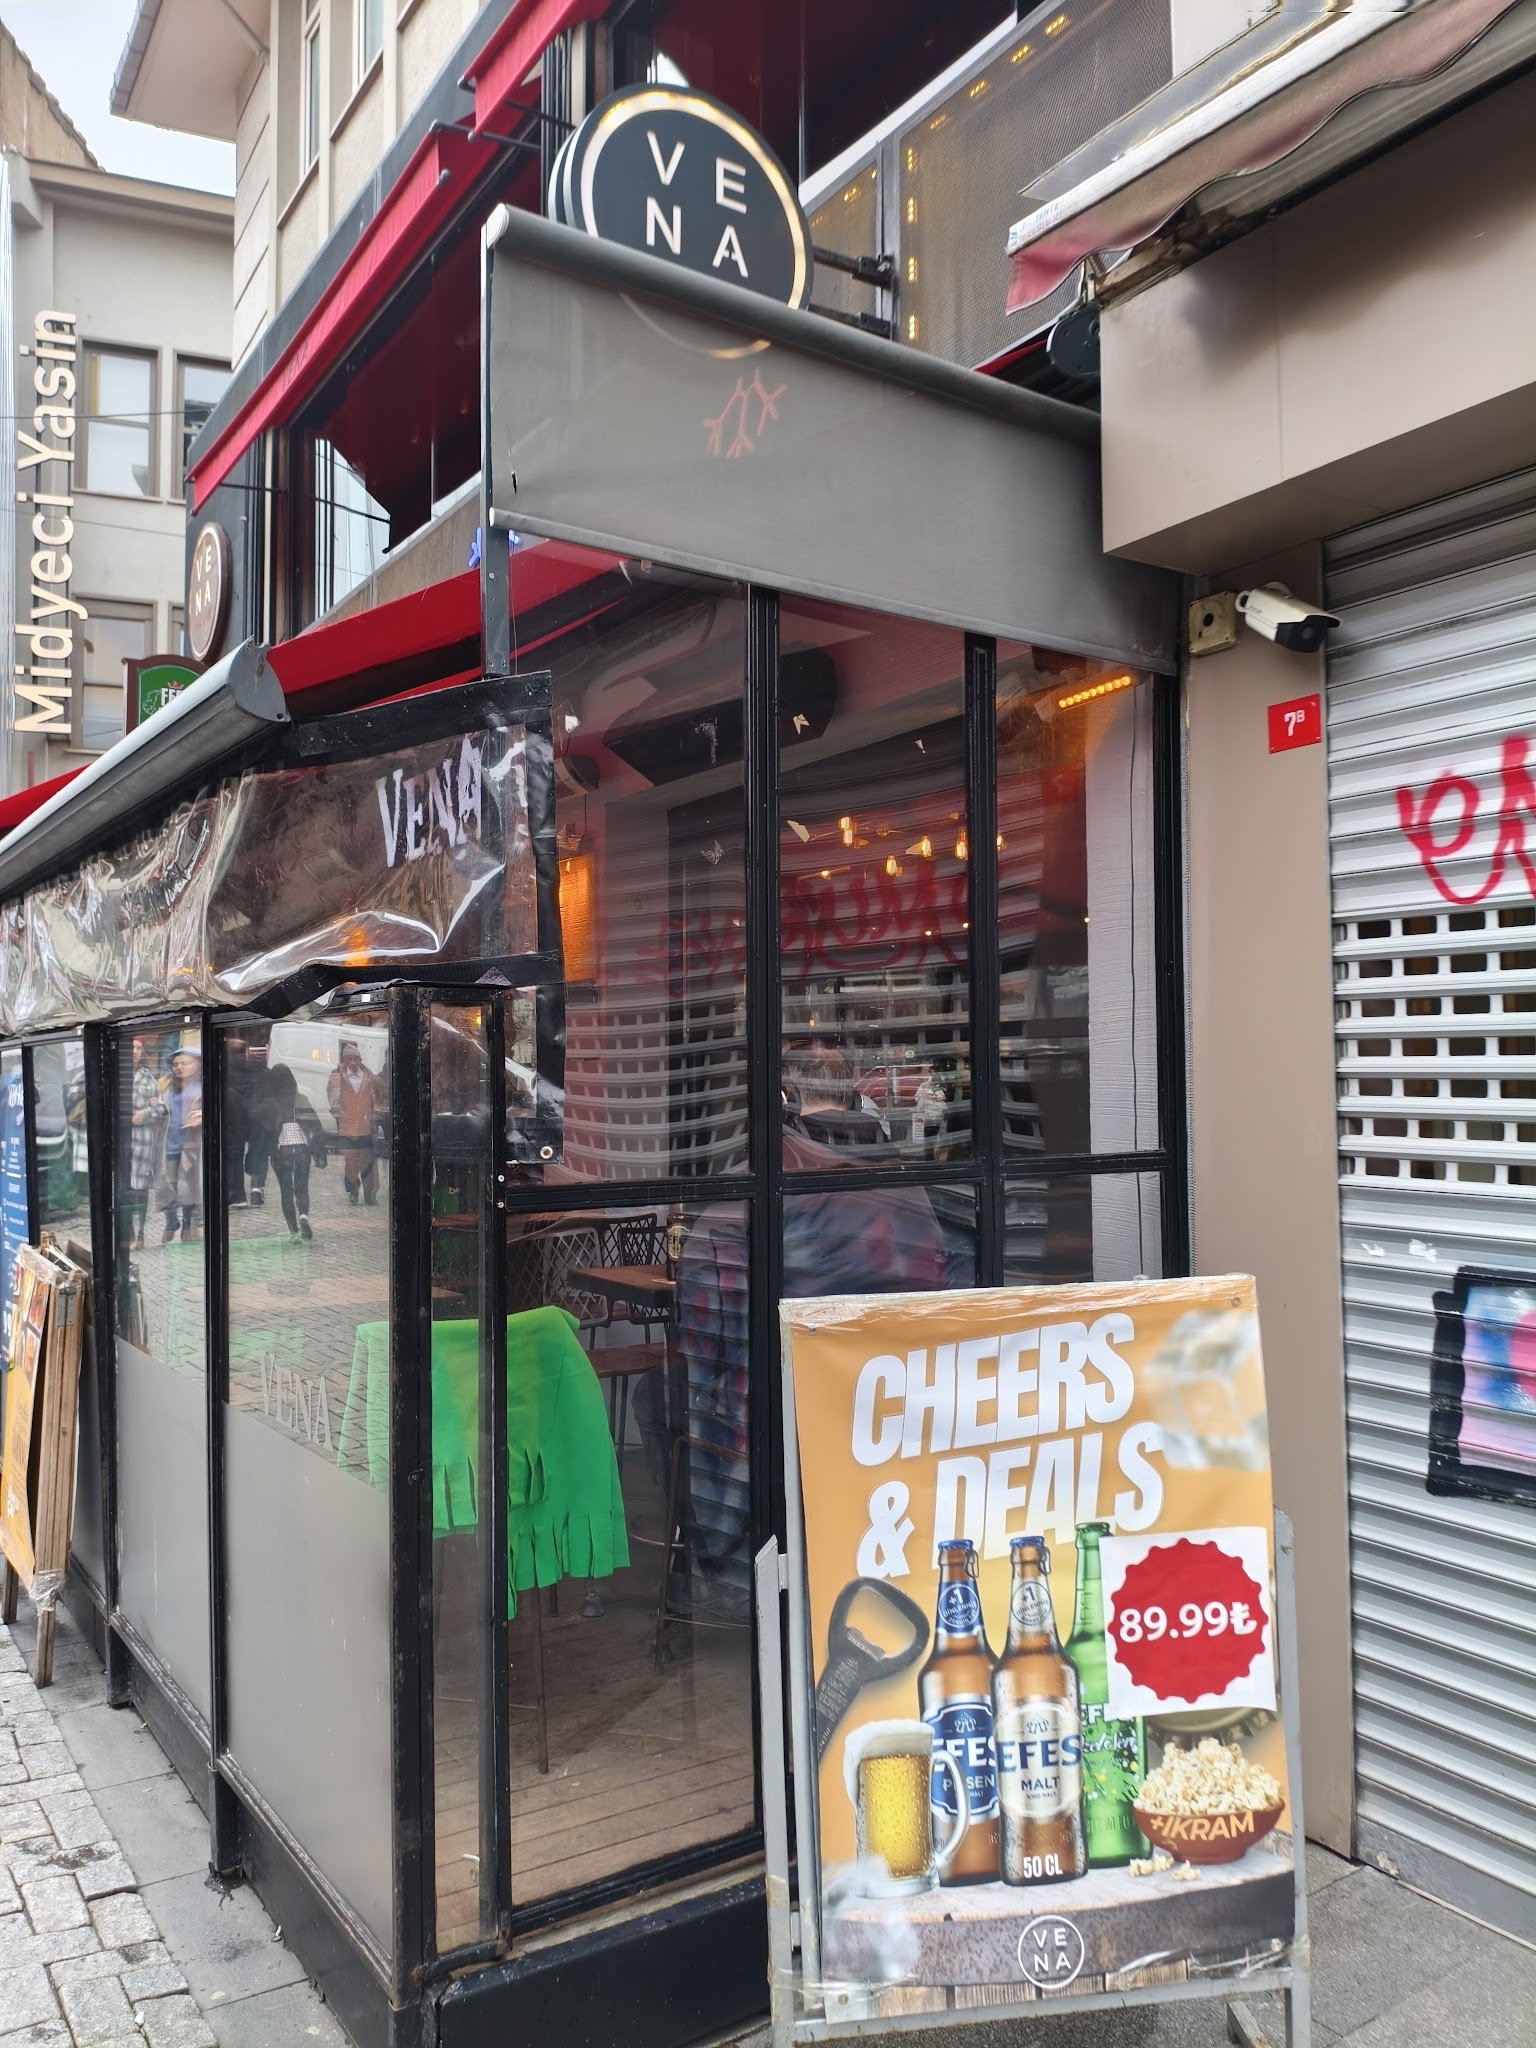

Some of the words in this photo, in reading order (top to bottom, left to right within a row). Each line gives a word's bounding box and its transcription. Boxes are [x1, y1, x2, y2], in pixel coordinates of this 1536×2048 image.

[18, 310, 77, 470] Yasin
[14, 492, 88, 734] Midyeci
[1284, 709, 1305, 737] 7B
[376, 732, 482, 868] VENA
[260, 1351, 334, 1453] VENA
[852, 1313, 1135, 1467] CHEERS
[856, 1480, 915, 1580] &
[931, 1421, 1165, 1571] DEALS
[943, 1774, 996, 1792] PSEN
[998, 1733, 1082, 1774] EFES
[1021, 1777, 1060, 1792] MALT
[1023, 1855, 1043, 1879] 50
[1044, 1853, 1063, 1876] CL
